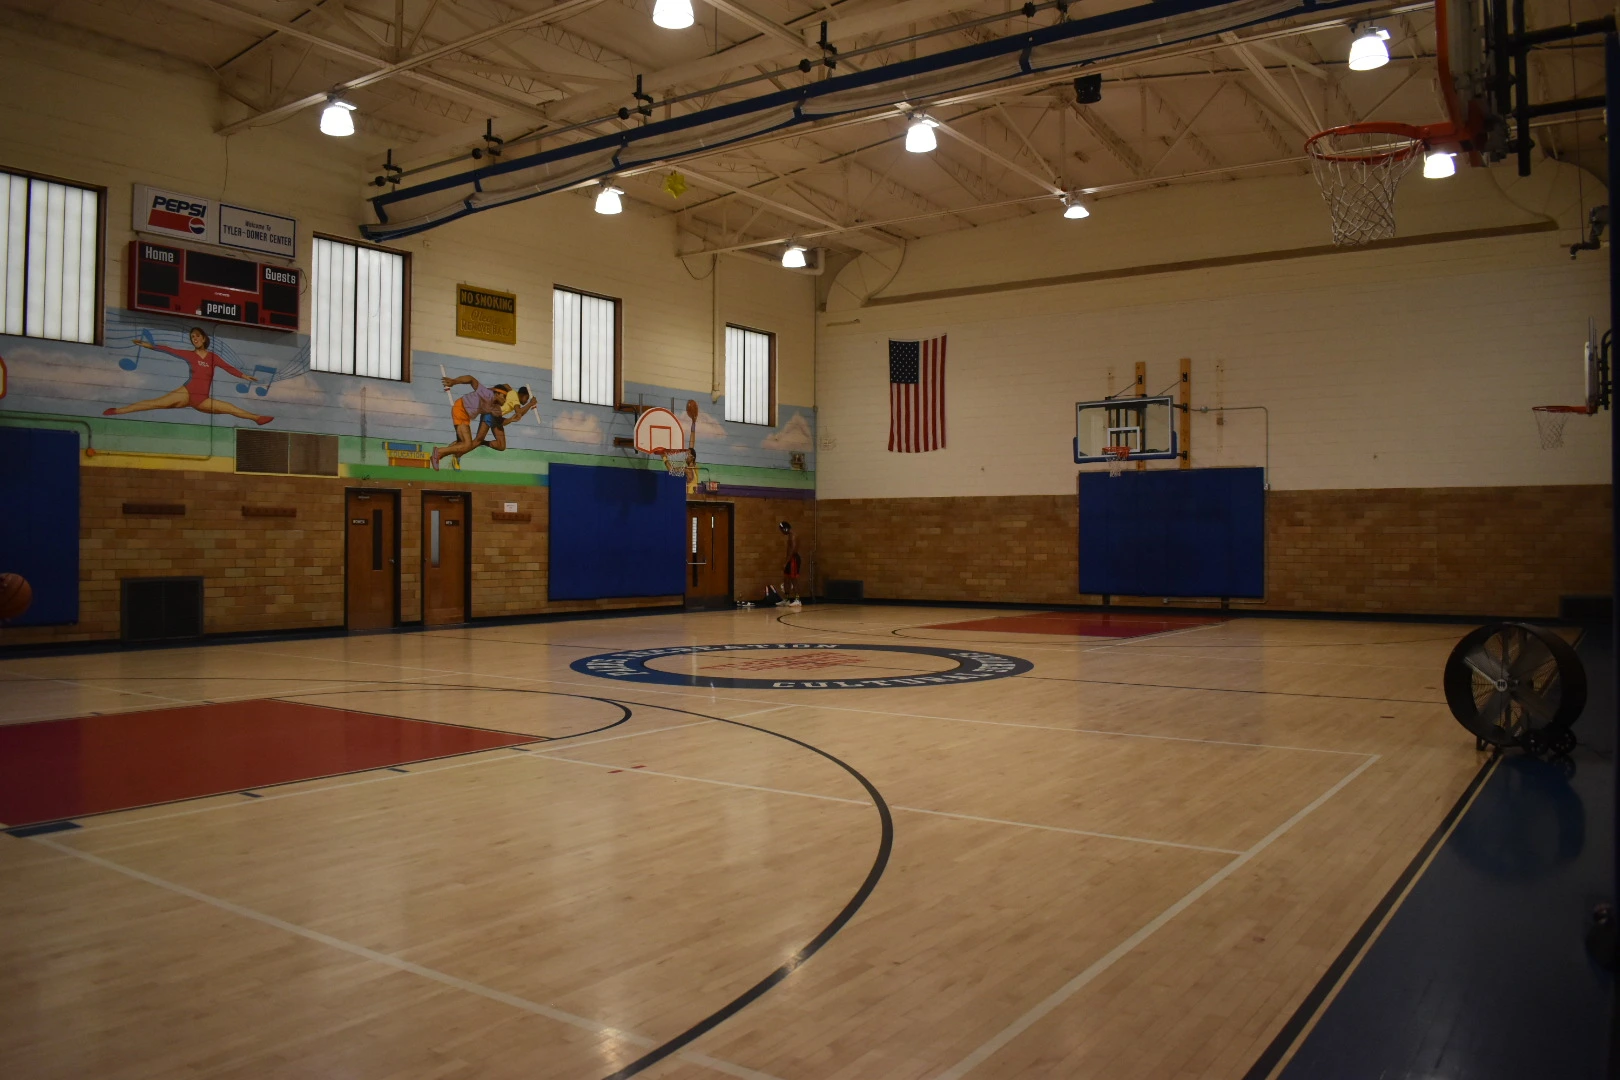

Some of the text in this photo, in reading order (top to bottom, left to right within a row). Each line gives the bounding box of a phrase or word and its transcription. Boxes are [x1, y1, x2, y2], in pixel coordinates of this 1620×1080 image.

[152, 195, 207, 218] PEPSI
[245, 221, 265, 230] Welcome
[269, 234, 292, 246] CENTER
[145, 246, 174, 263] Home
[265, 268, 296, 284] Guests
[206, 303, 236, 316] period
[461, 291, 513, 312] NO SMOKING
[461, 319, 490, 335] REMOVE
[390, 450, 425, 459] EDUCATION
[772, 672, 994, 688] CULTURAL
